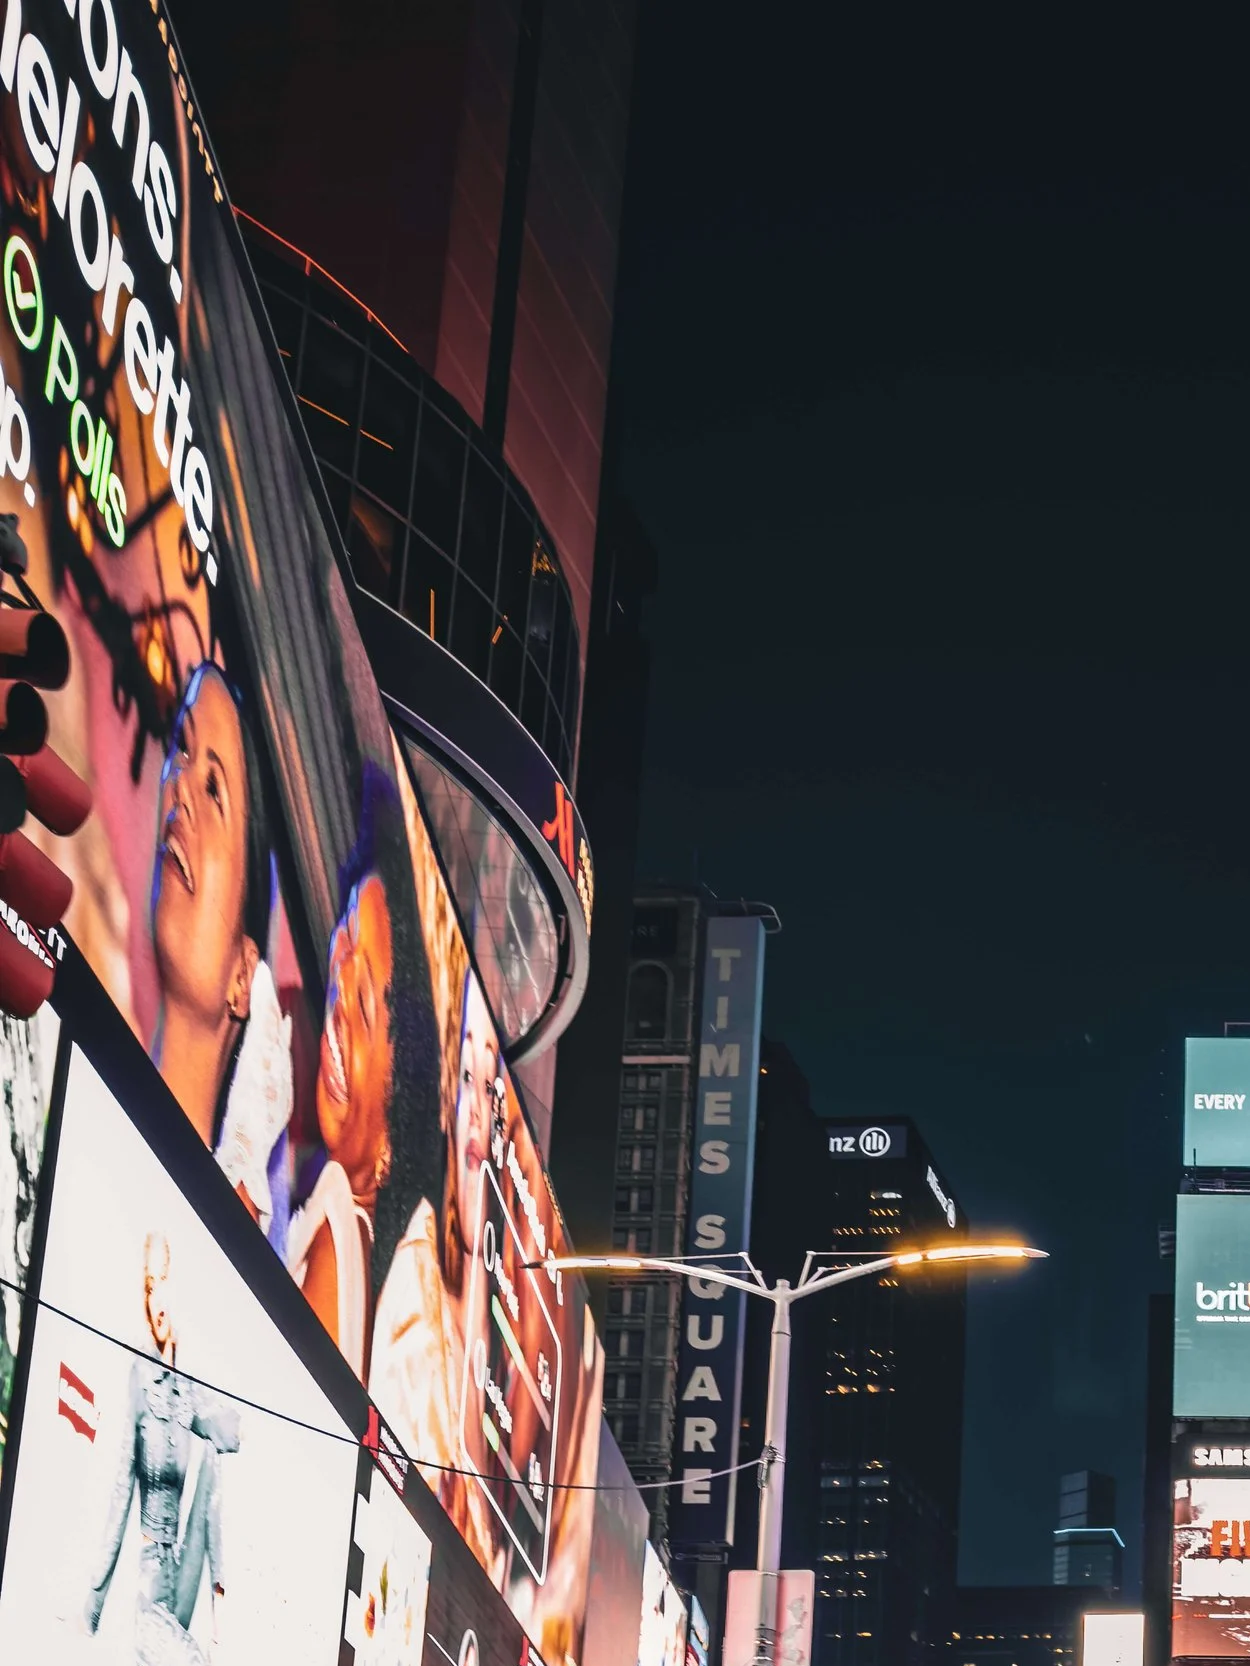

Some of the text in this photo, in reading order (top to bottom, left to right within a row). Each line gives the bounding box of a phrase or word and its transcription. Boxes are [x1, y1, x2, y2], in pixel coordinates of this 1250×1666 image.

[63, 0, 183, 304] ons.
[45, 315, 127, 548] Polls
[680, 948, 741, 1505] TIMES SQUARE
[1194, 1093, 1246, 1110] EVERY
